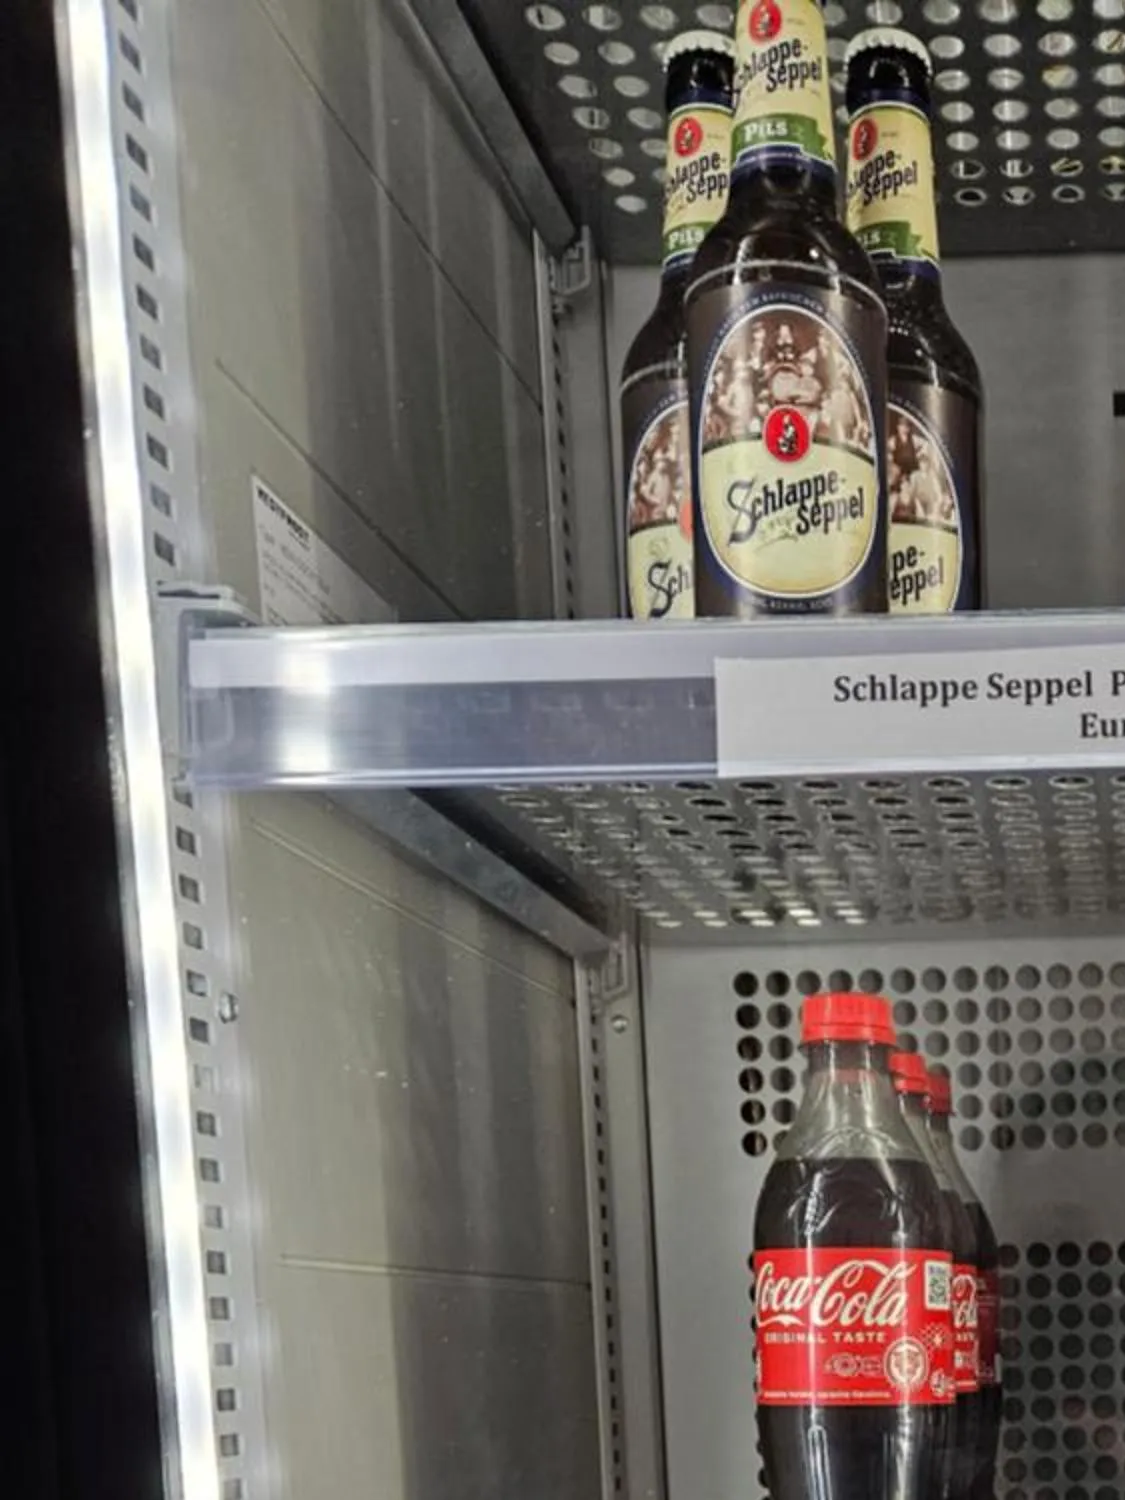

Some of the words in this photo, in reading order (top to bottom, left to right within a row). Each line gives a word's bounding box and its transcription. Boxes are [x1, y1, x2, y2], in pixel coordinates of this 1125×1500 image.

[686, 172, 729, 203] Sepp
[863, 161, 918, 206] Seppel
[796, 489, 864, 535] Seppel
[890, 555, 945, 606] eppel
[834, 674, 978, 708] Schlappe
[986, 670, 1093, 706] Seppel
[833, 1332, 886, 1344] TASTE
